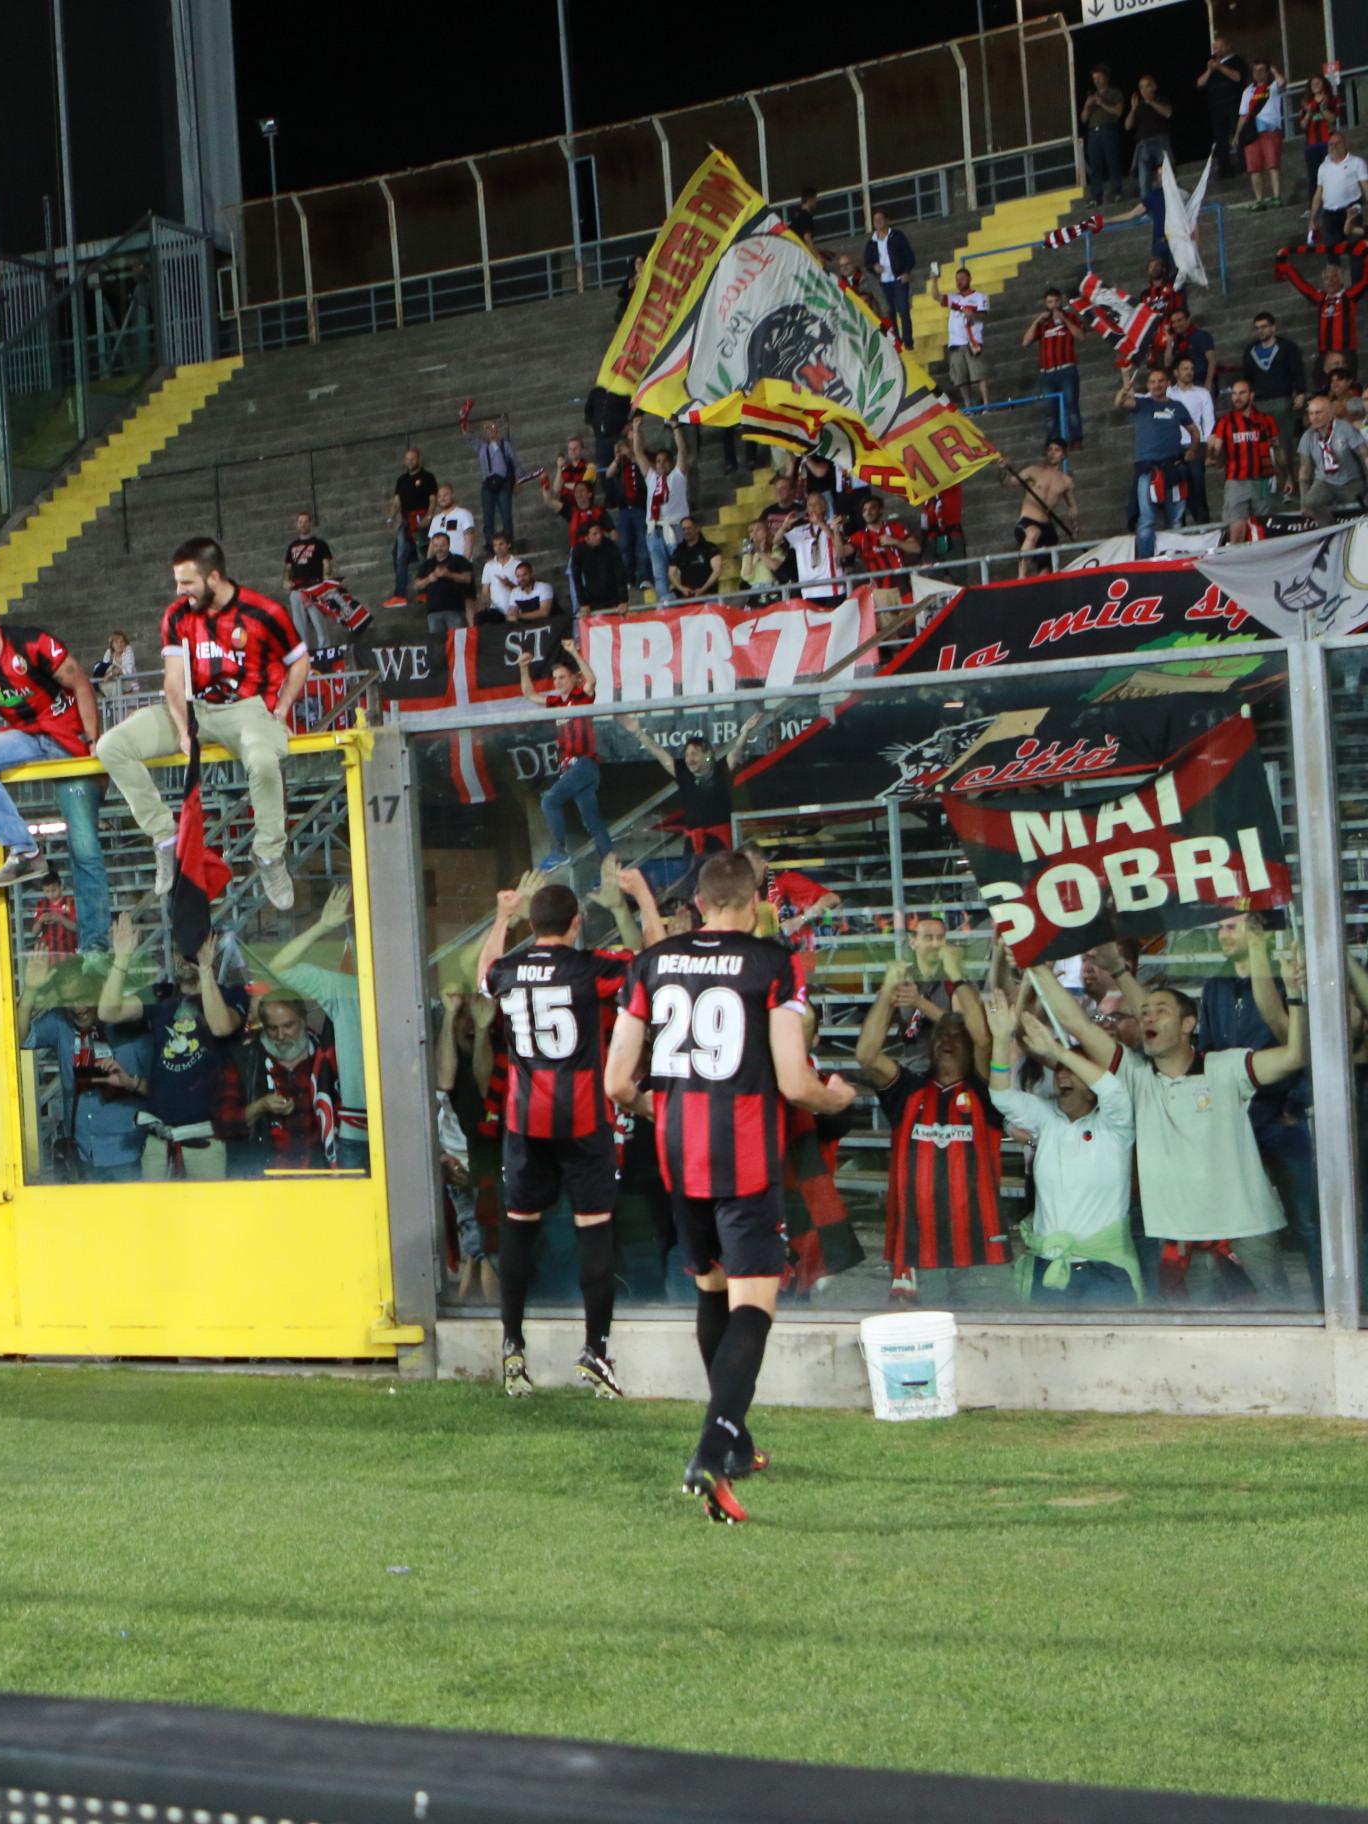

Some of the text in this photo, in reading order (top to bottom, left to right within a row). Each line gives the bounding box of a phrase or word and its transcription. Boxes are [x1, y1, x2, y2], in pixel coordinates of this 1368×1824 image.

[936, 641, 1009, 672] la
[1029, 578, 1163, 648] mia
[372, 646, 430, 683] WE
[950, 733, 1120, 791] città
[368, 795, 400, 824] 17
[1009, 770, 1182, 864] MAI
[979, 826, 1272, 947] SOBRI
[657, 954, 744, 976] DERMAKU
[500, 985, 579, 1060] 15
[650, 984, 746, 1081] 29
